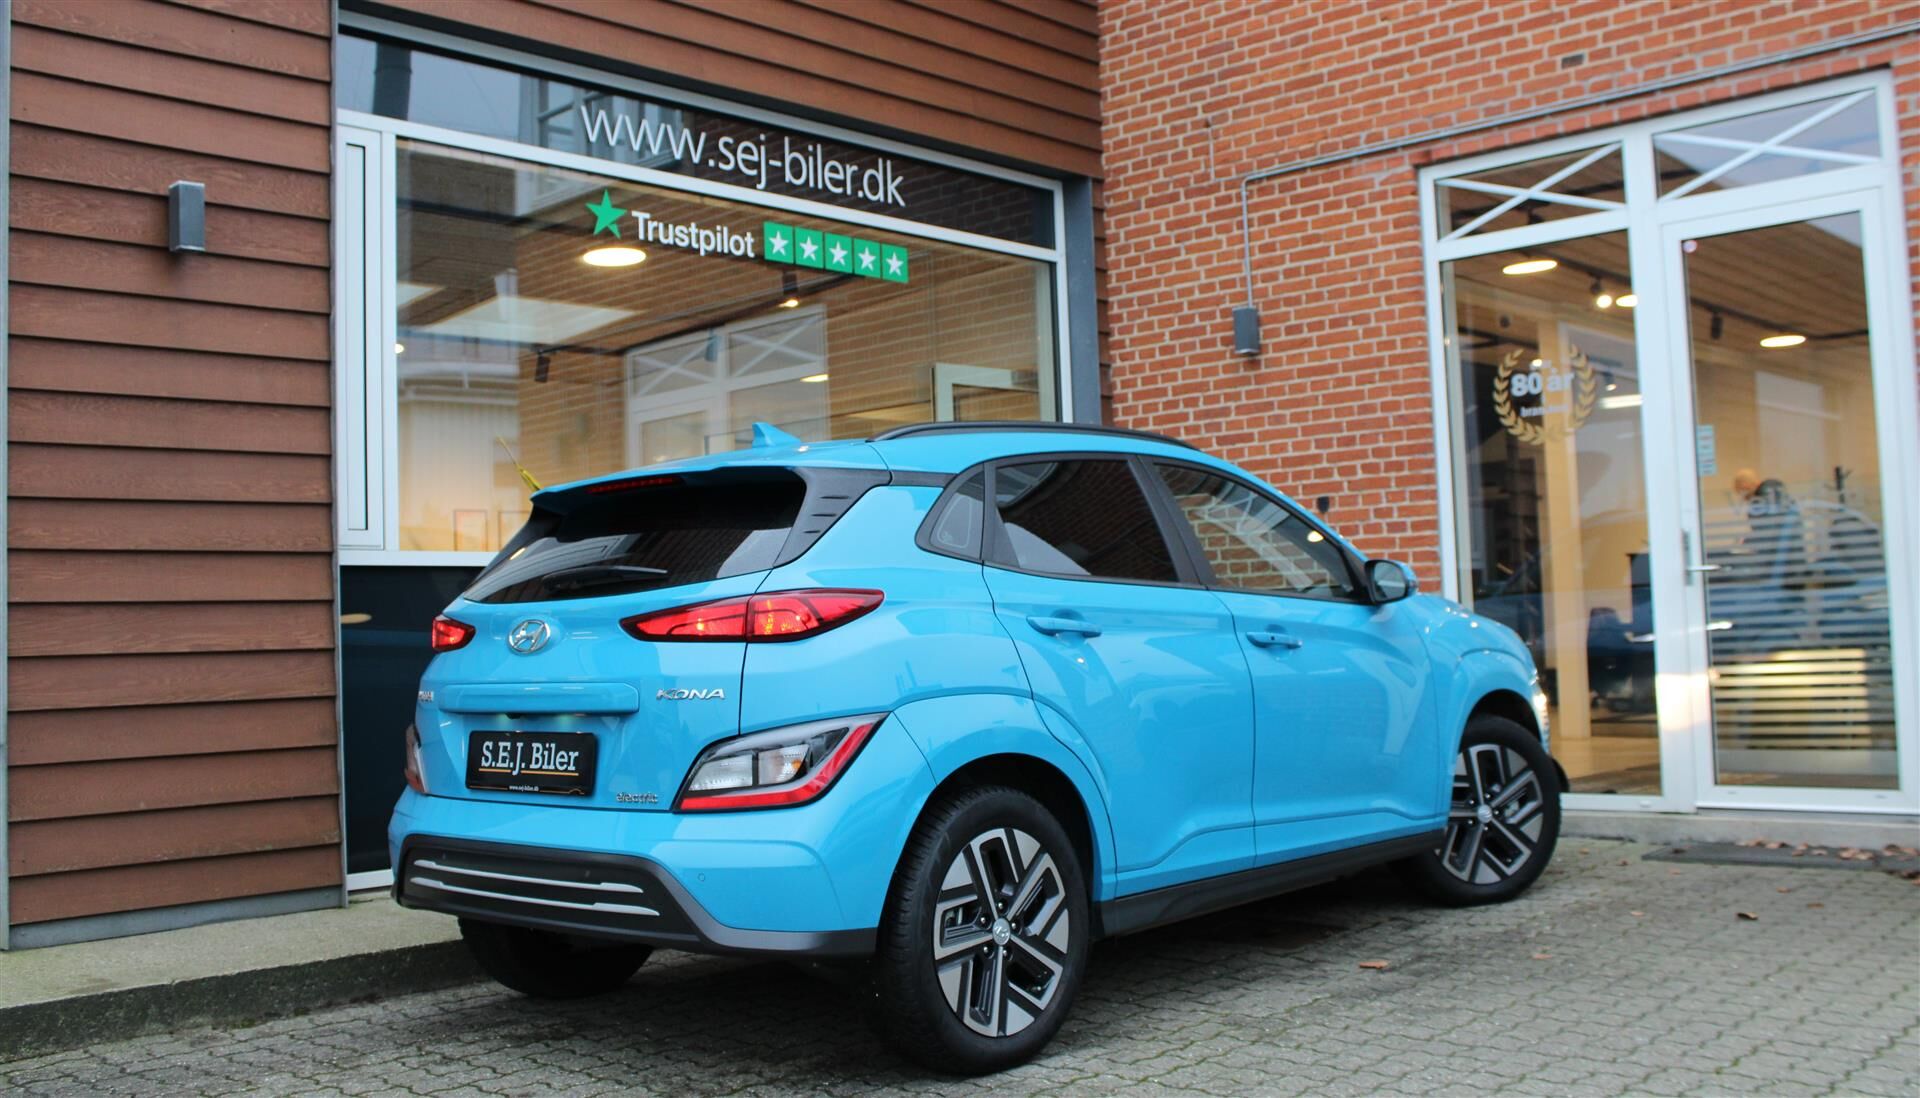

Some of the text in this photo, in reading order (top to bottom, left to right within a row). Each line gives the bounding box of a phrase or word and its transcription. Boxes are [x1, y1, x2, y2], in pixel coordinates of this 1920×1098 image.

[581, 105, 905, 207] www.sej-biler.dk
[632, 210, 755, 258] Trustpilot
[1511, 372, 1542, 397] 80
[656, 688, 726, 700] KONA
[480, 741, 579, 775] S.E.J. Biler
